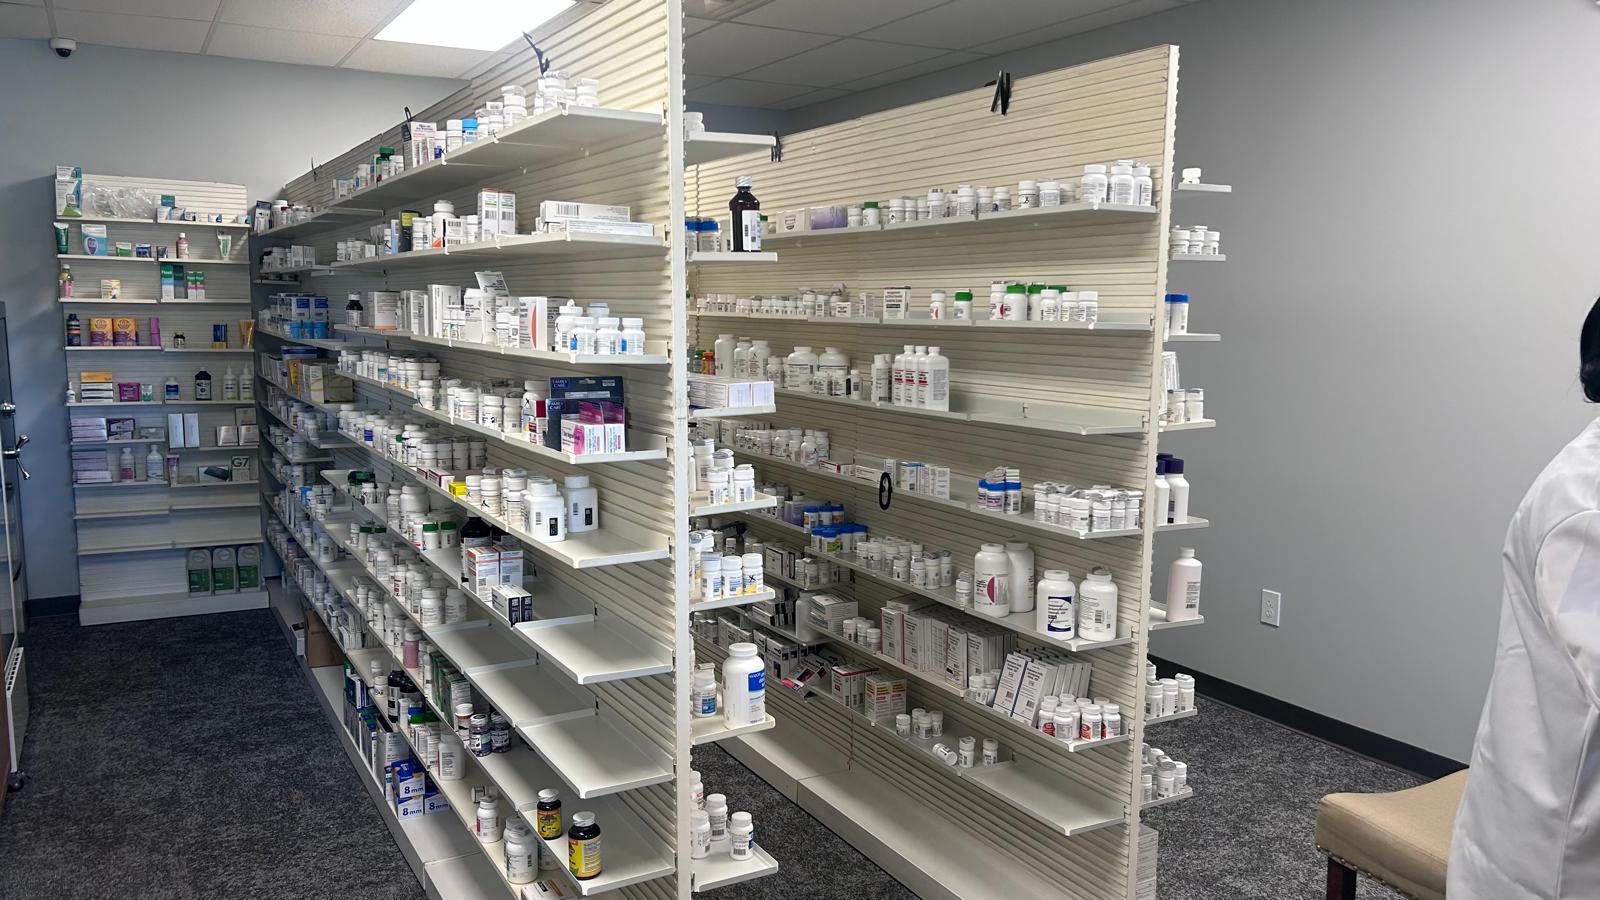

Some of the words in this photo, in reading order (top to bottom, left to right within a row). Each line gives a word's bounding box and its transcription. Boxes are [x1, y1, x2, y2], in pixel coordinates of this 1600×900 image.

[232, 457, 249, 468] G7
[404, 786, 411, 794] 8
[429, 802, 435, 810] 8
[402, 808, 409, 816] 8
